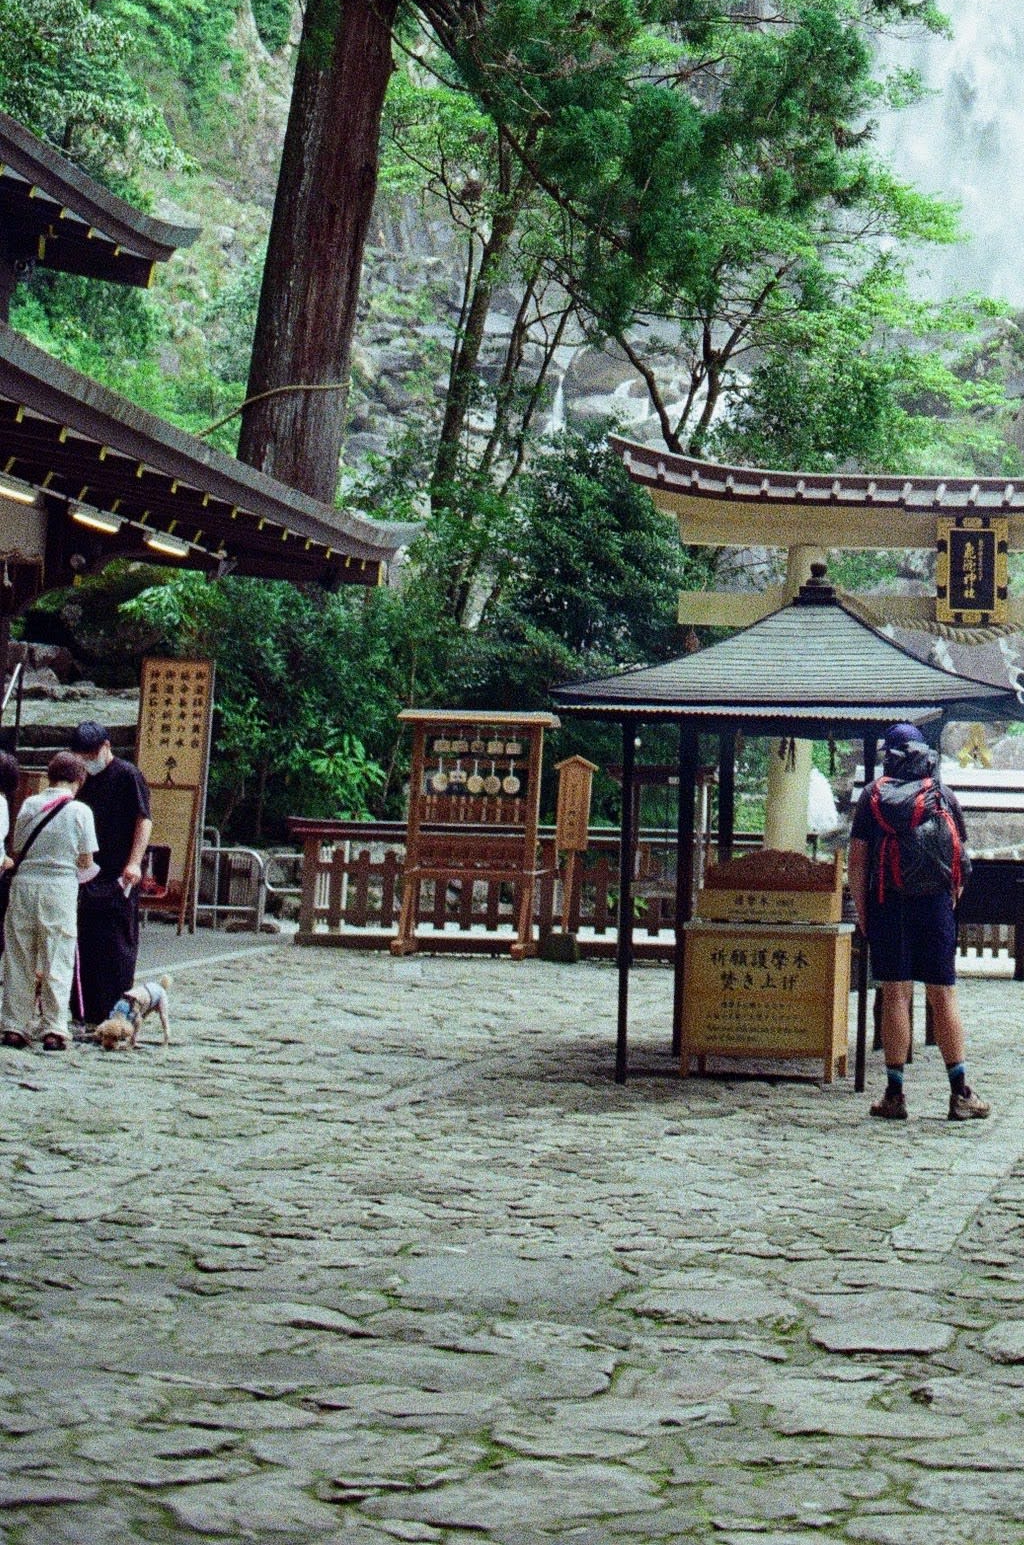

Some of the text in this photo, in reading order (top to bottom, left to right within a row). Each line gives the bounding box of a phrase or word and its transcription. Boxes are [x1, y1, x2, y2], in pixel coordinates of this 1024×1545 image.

[710, 948, 808, 970] 祈願護摩木
[720, 971, 798, 990] 焚き上げ
